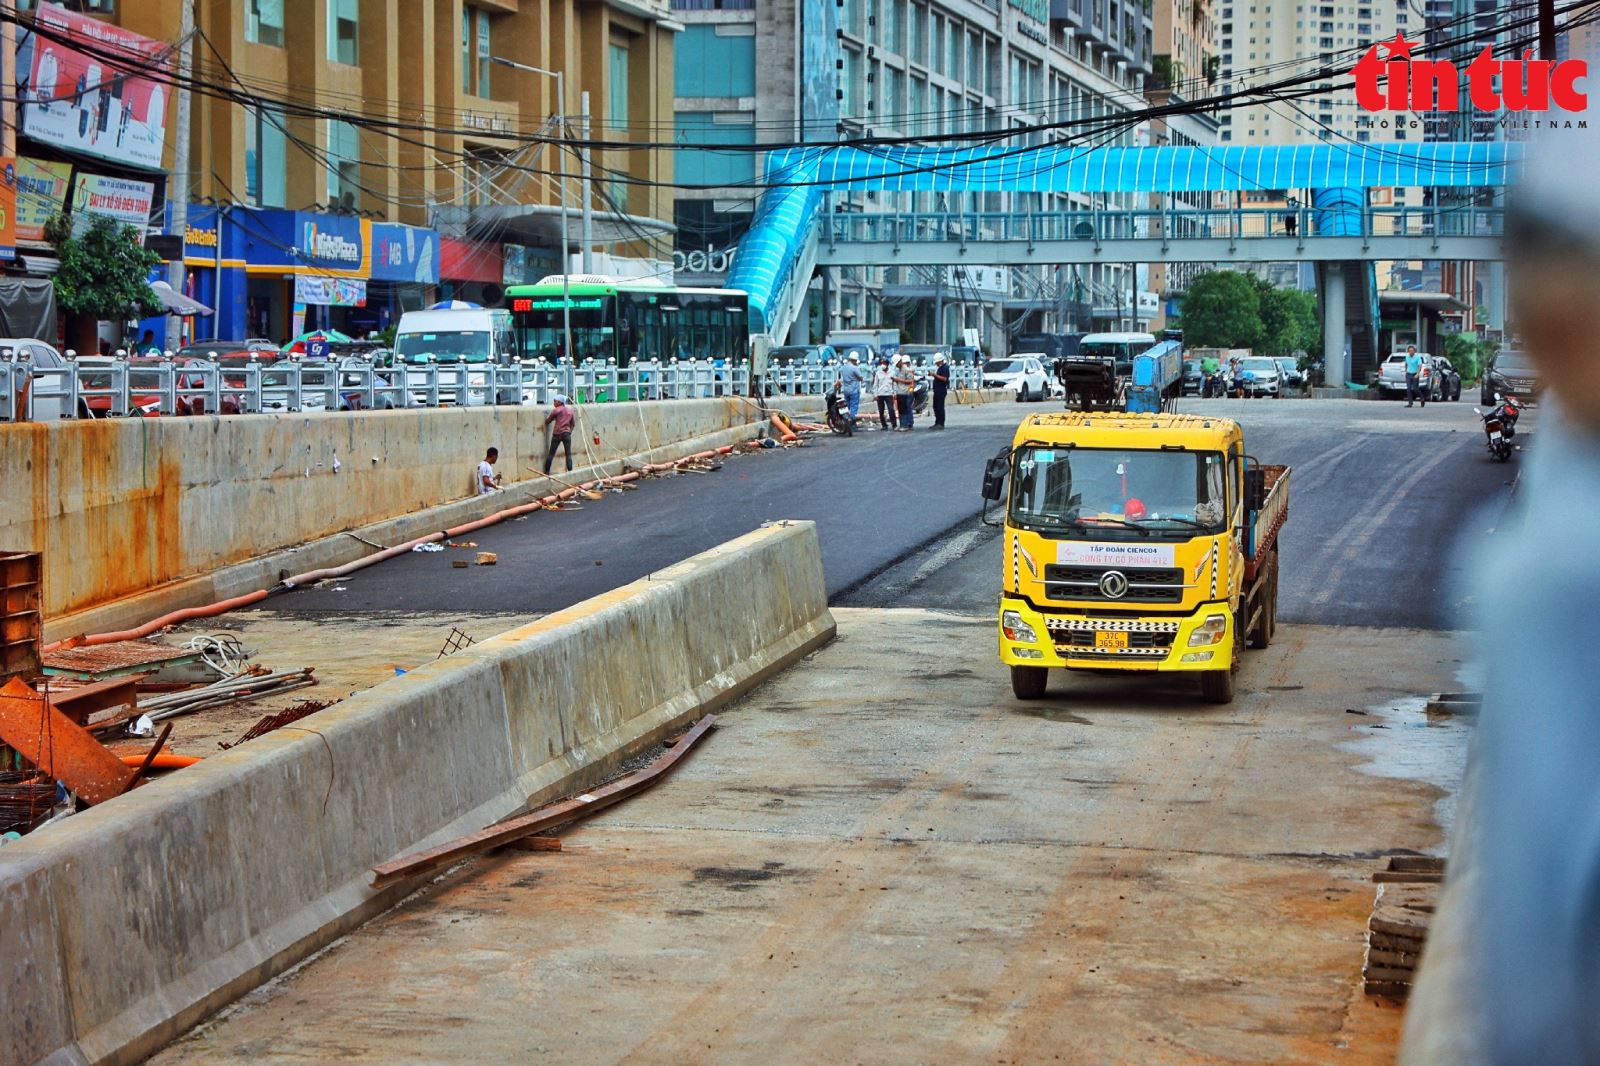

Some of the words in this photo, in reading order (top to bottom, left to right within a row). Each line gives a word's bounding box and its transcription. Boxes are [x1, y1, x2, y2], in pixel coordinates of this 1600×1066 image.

[389, 242, 402, 265] MB
[1090, 545, 1104, 554] TẬP
[1104, 555, 1113, 564] TY
[1153, 557, 1168, 565] 412
[1105, 632, 1119, 640] 37C
